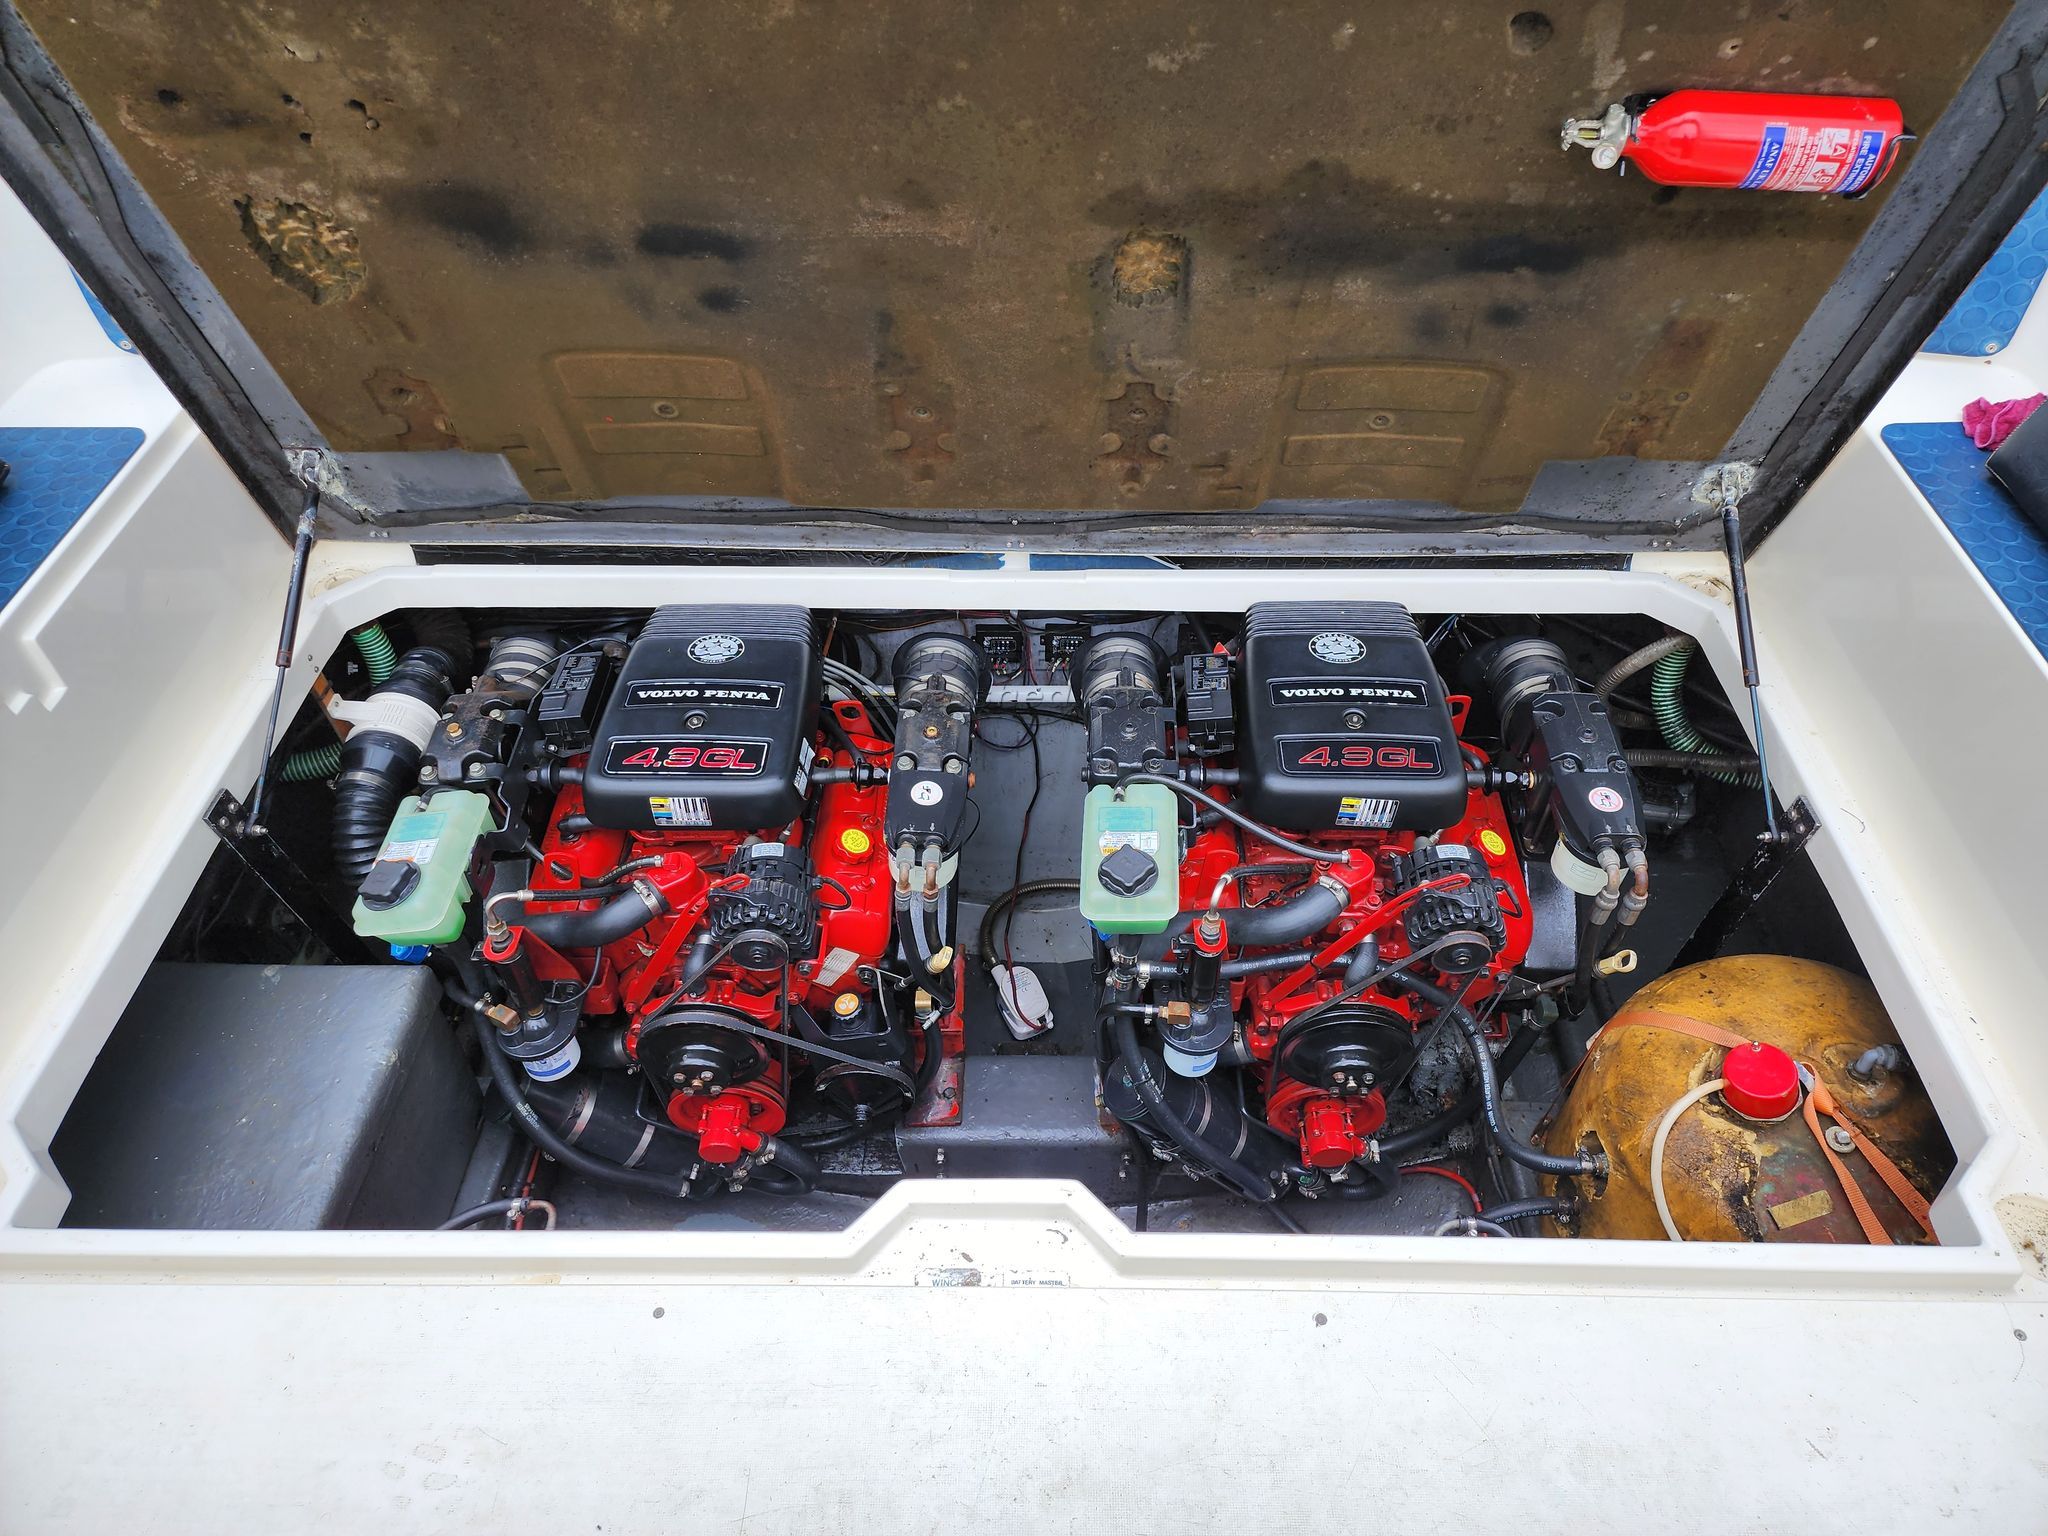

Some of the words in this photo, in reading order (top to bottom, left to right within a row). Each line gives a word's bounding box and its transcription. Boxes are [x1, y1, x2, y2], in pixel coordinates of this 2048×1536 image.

[1859, 135, 1872, 156] FIRE
[637, 689, 699, 699] VOLVO
[703, 689, 770, 700] PENTA
[1280, 687, 1344, 698] VOLVO
[1349, 687, 1417, 699] PENTA
[622, 747, 756, 770] 4.3GL
[1299, 746, 1434, 769] 4.3GL
[1038, 1279, 1064, 1287] MASTER
